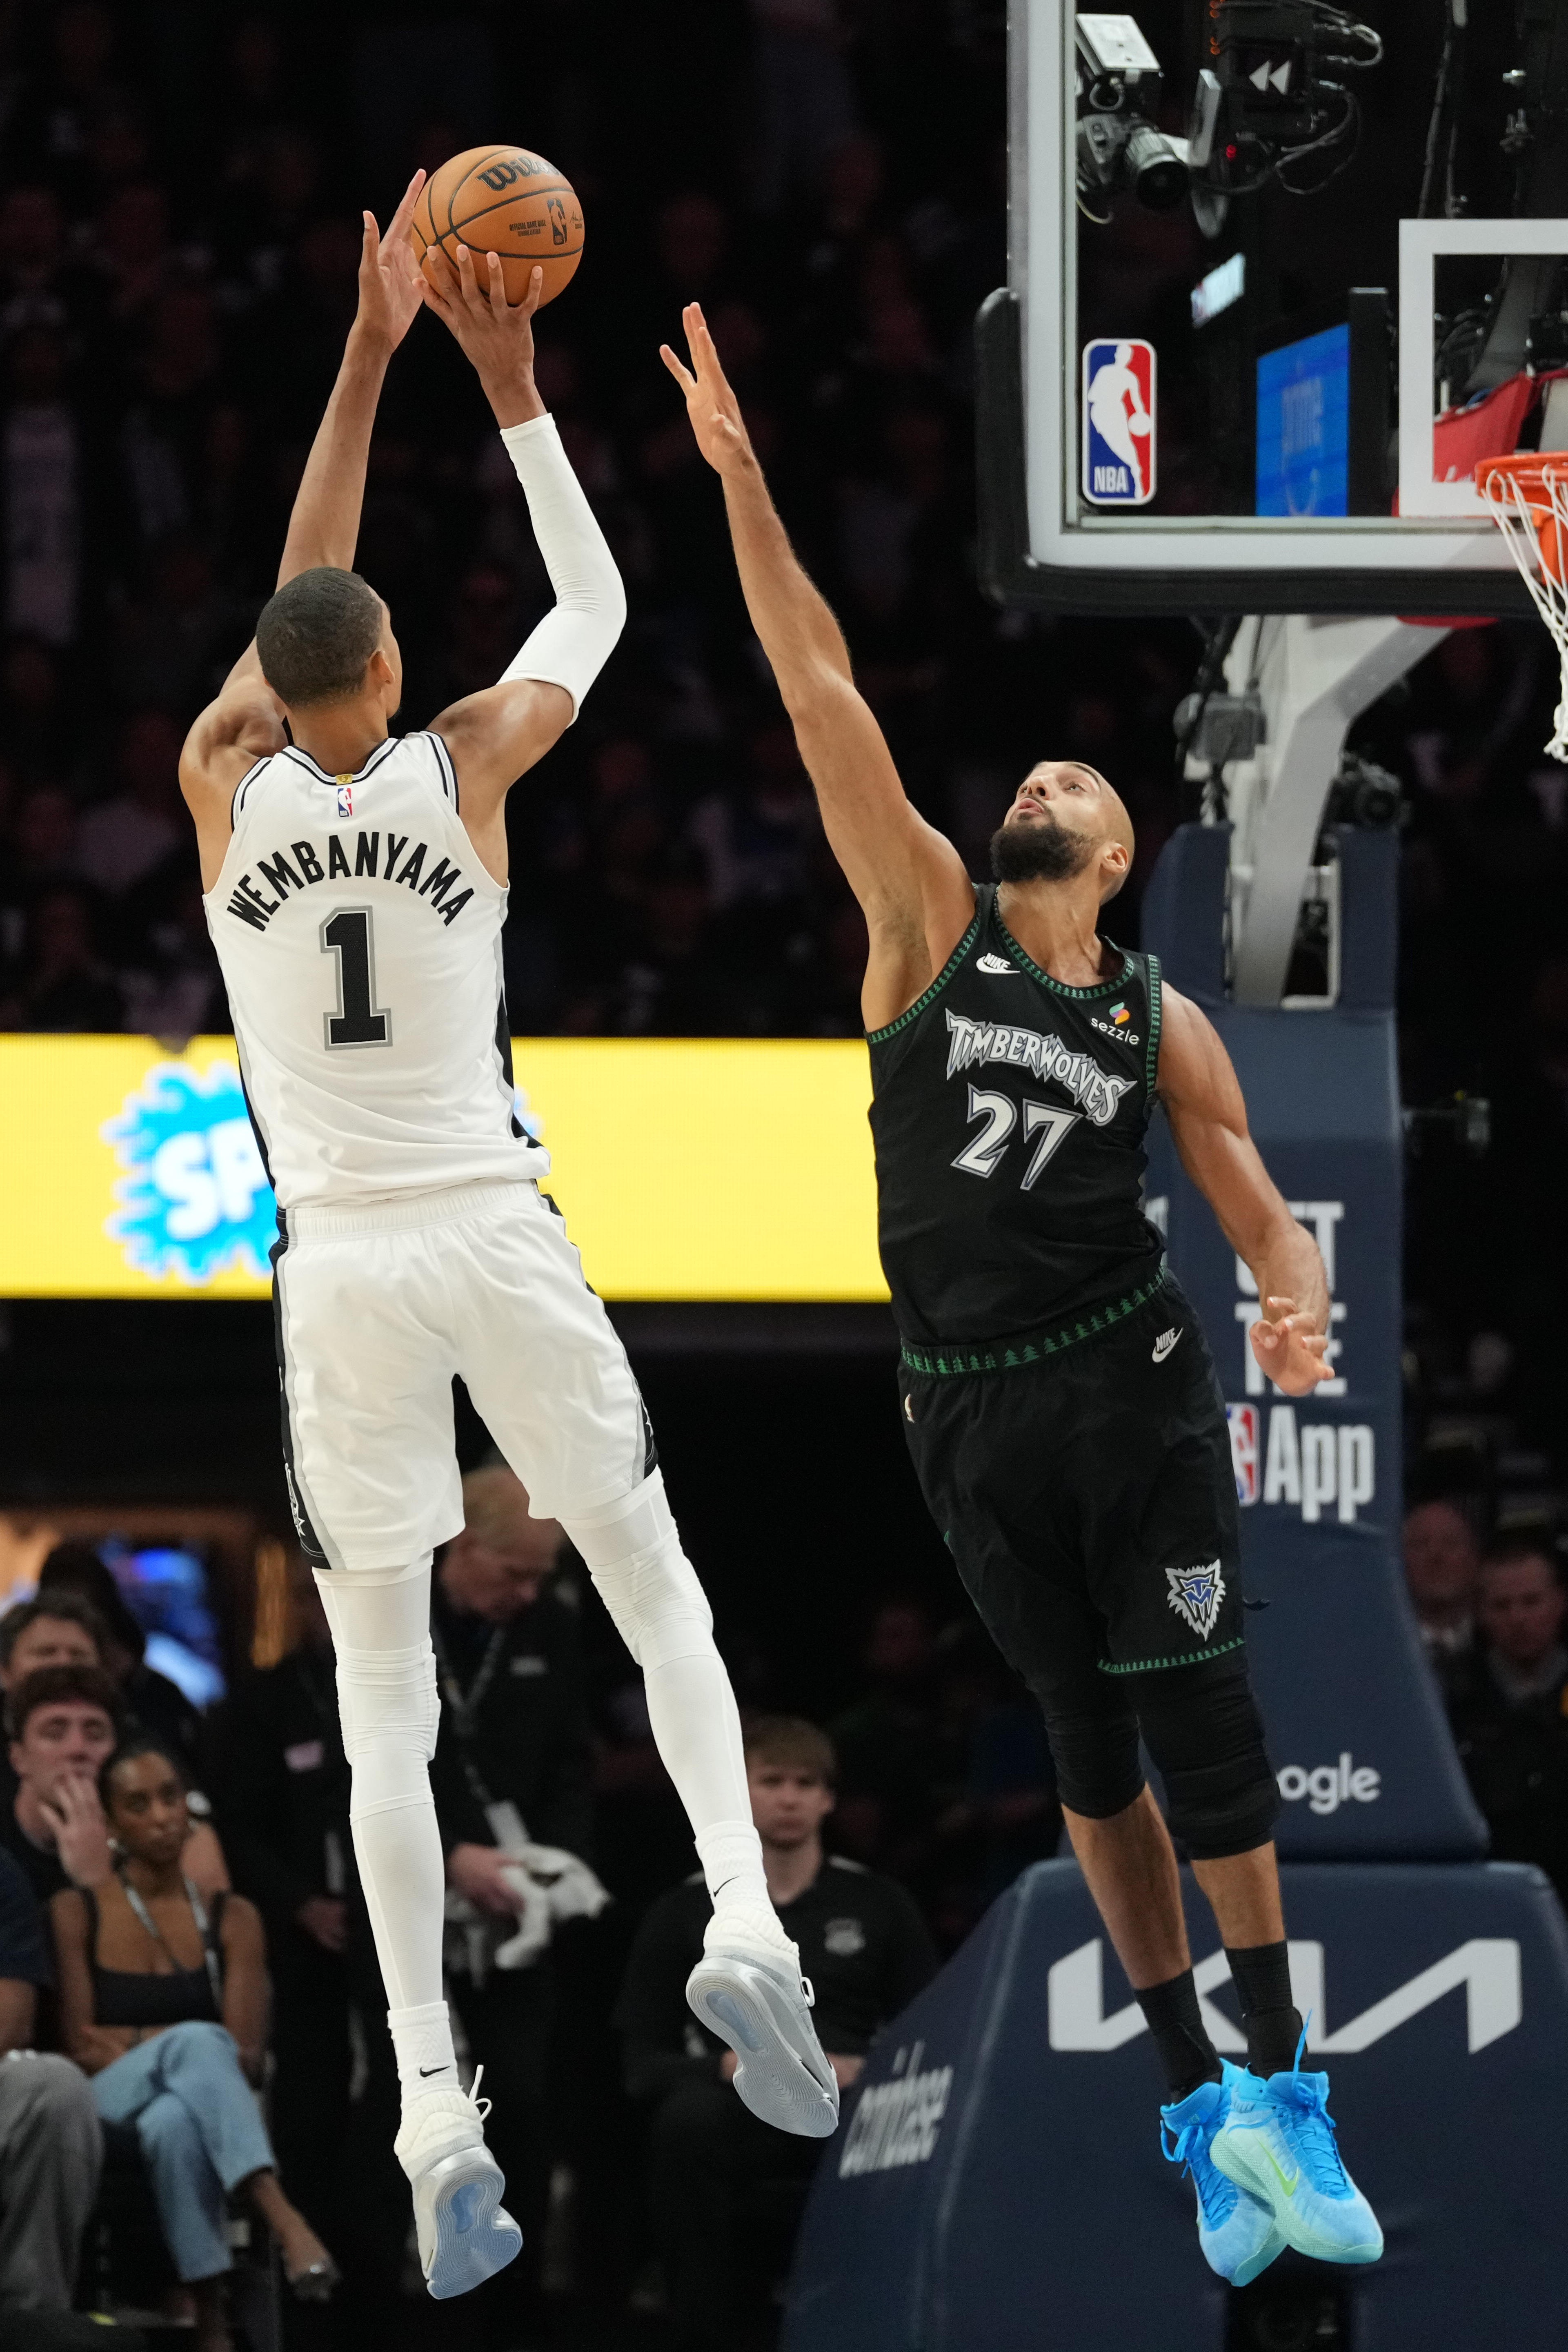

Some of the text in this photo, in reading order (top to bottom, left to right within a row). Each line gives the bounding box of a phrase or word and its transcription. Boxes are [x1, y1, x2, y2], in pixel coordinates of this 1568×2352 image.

[1094, 466, 1129, 493] NBA
[227, 831, 474, 932] WEMBANYAMA
[319, 905, 393, 1051] 1
[983, 952, 1011, 970] NIKE
[1090, 1018, 1140, 1045] sezzle
[950, 1082, 1083, 1191] 27
[1155, 1327, 1177, 1352] NIKE
[1263, 1404, 1375, 1523] App
[1276, 1751, 1381, 1815] ogle
